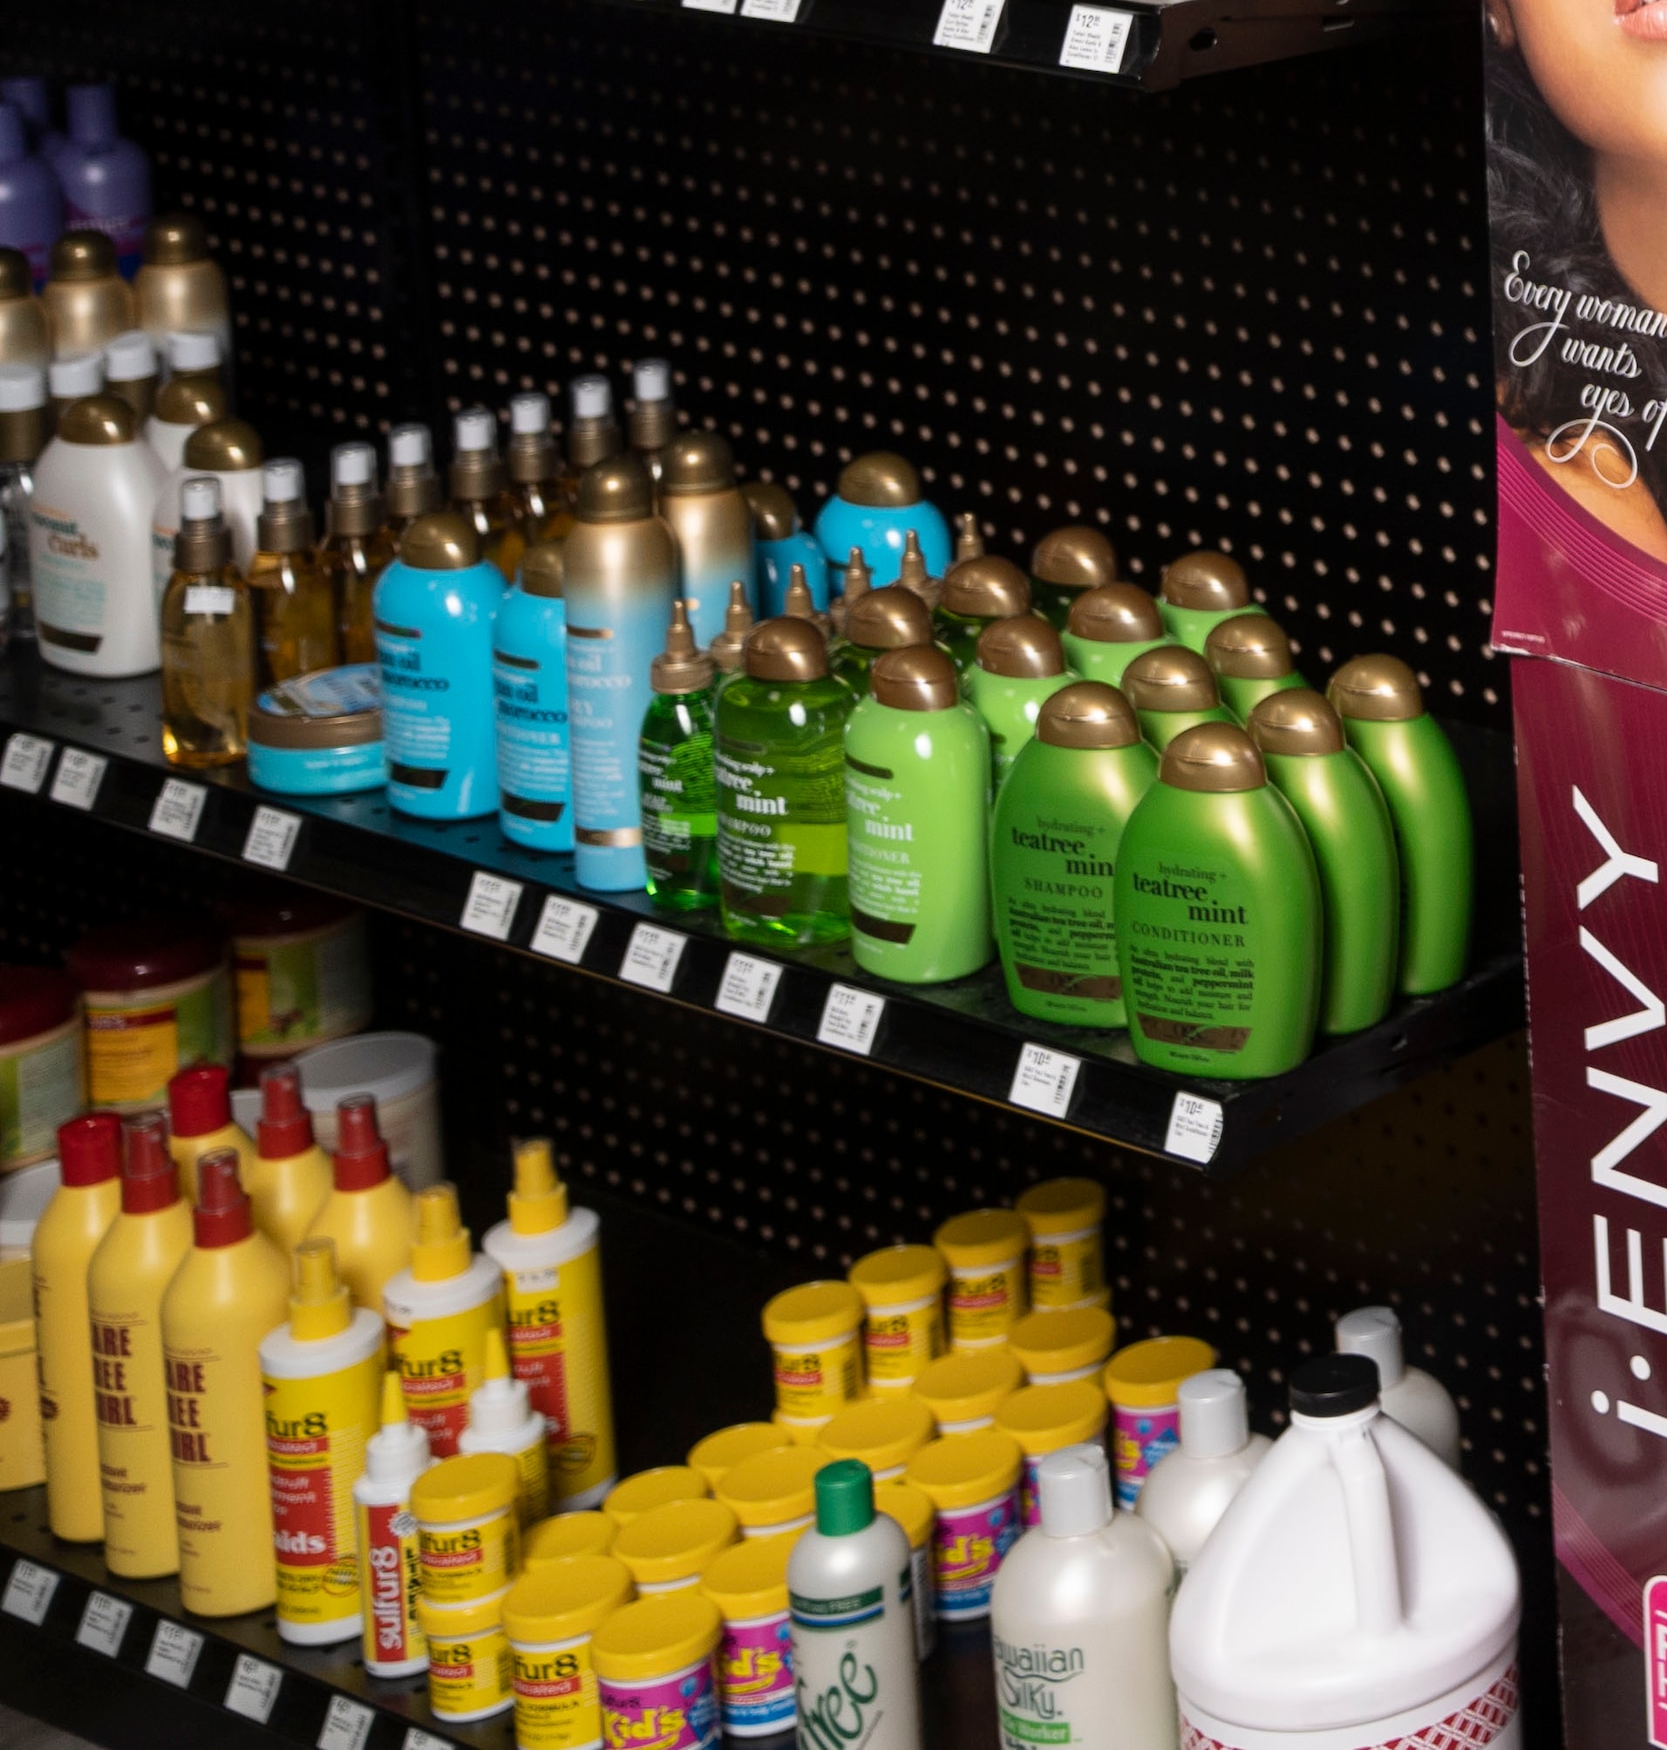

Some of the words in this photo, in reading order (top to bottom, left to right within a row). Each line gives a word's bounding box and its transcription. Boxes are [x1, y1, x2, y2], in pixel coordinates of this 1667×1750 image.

[1504, 251, 1570, 367] Every
[1561, 334, 1642, 378] wants
[1546, 382, 1638, 489] eyes
[735, 790, 787, 815] mint
[865, 816, 913, 841] mint
[1037, 816, 1093, 836] hydrating
[1011, 827, 1085, 854] teatree
[1066, 854, 1114, 877] min
[1159, 862, 1217, 882] hydrating
[1024, 877, 1104, 899] SHAMPOO
[1132, 873, 1207, 901] teatree
[1188, 901, 1248, 925] mint
[1131, 921, 1246, 947] CONDITIONER
[399, 1350, 464, 1377] fur8
[266, 1411, 328, 1438] fur8
[274, 1532, 326, 1554] aids
[370, 1545, 402, 1650] sulfur8
[514, 1654, 579, 1682] lfur8
[603, 1707, 686, 1748] Kid's
